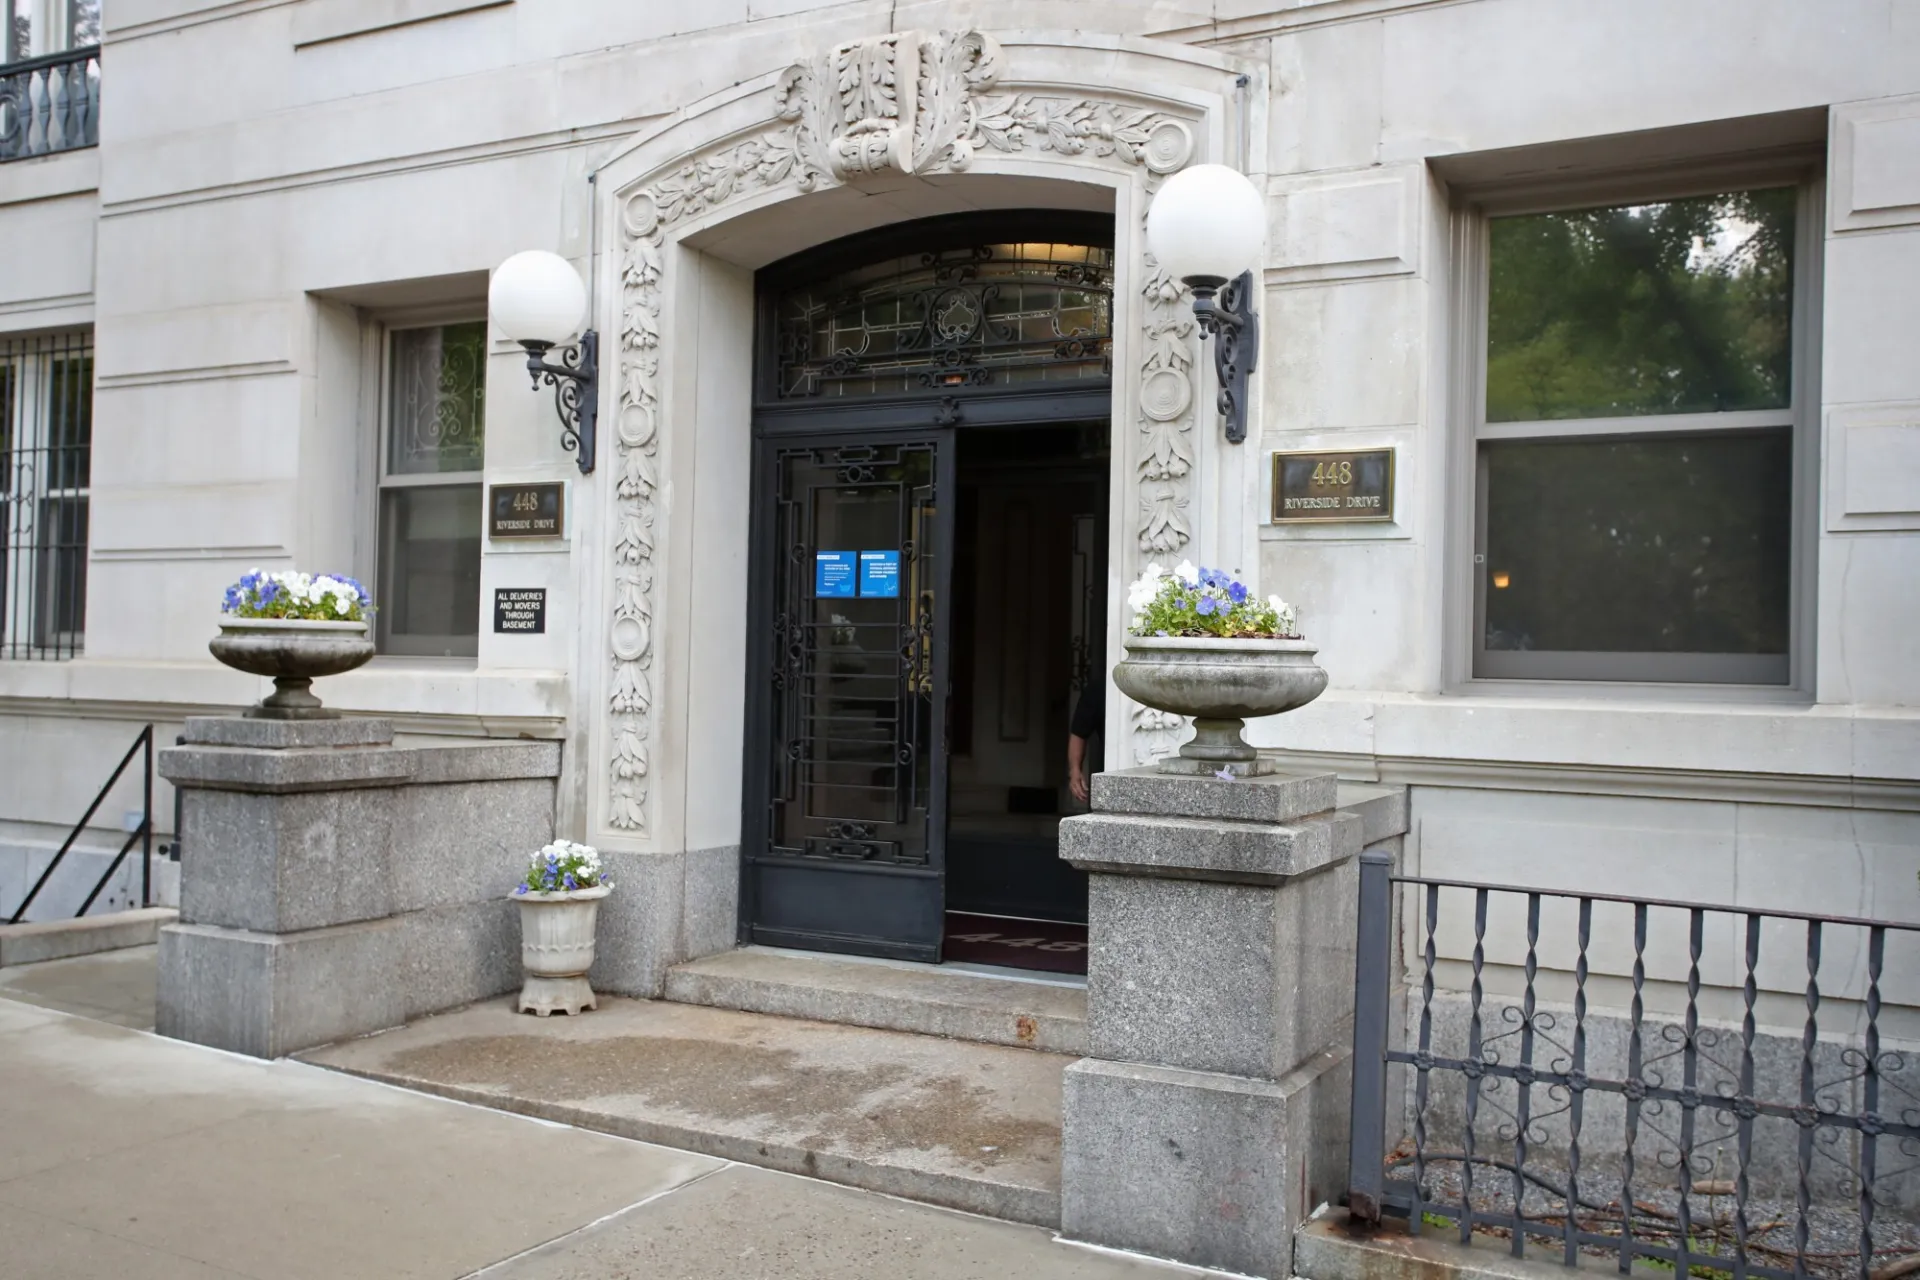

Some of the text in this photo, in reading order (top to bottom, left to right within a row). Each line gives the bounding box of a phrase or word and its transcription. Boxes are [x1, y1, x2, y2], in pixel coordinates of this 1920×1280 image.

[1312, 461, 1352, 485] 448
[513, 492, 538, 511] 448
[1284, 496, 1381, 510] RIVERSIDE DRIVE
[496, 519, 555, 530] RIVERSIDE DRIVE
[498, 592, 543, 600] ALL DELIVERIES
[500, 602, 540, 610] AND MOVERS
[505, 611, 535, 619] THROUGH
[502, 620, 535, 629] BASEMENT
[948, 933, 1089, 952] 448
